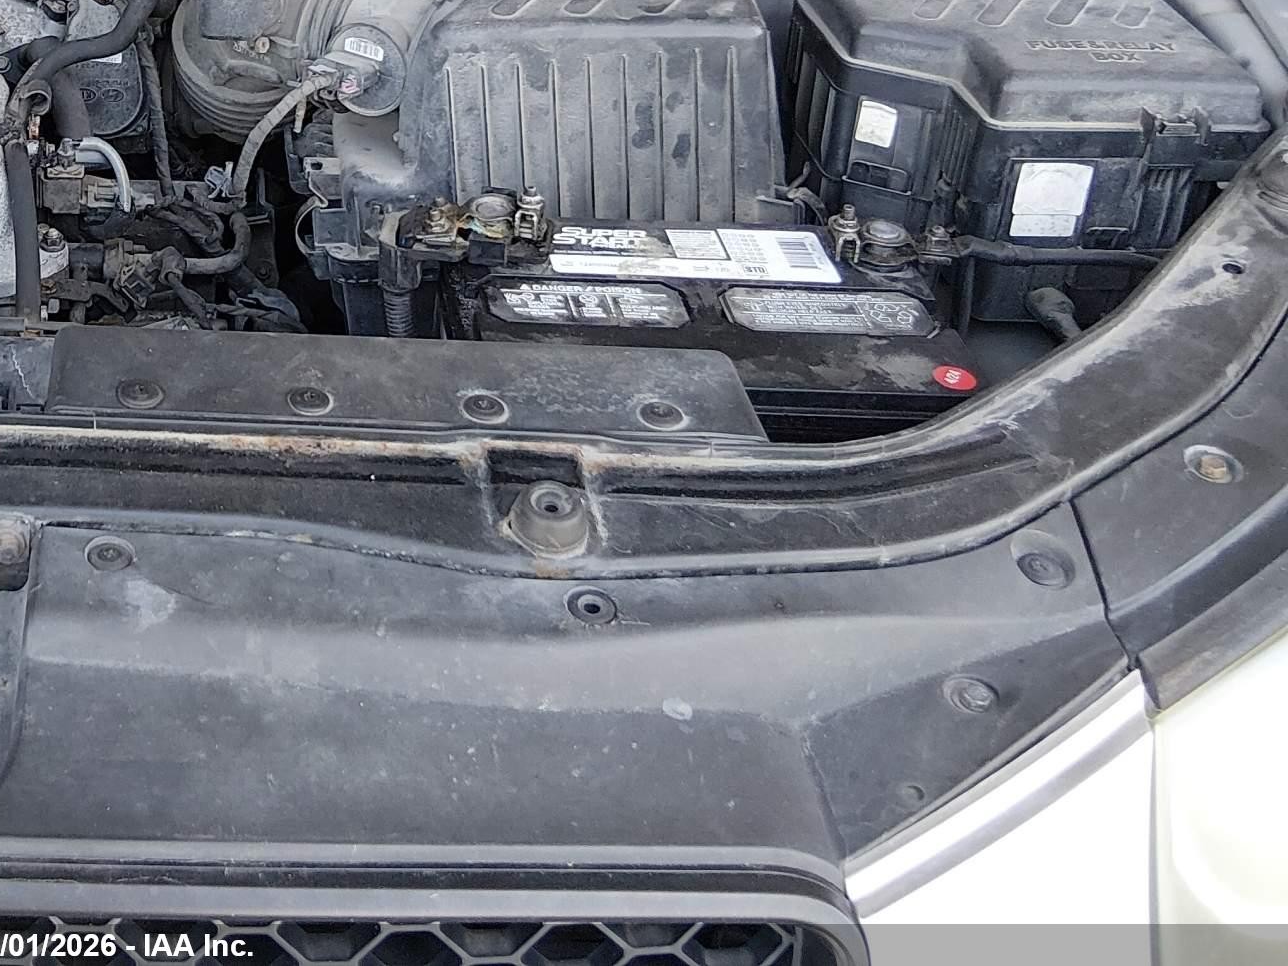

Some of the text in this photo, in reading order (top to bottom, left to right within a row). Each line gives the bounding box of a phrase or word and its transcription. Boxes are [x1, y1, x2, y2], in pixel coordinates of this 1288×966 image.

[1089, 51, 1146, 63] BOX
[560, 226, 648, 238] SUPER
[552, 233, 642, 249] START
[532, 284, 583, 293] DANGER
[594, 286, 642, 295] POISON
